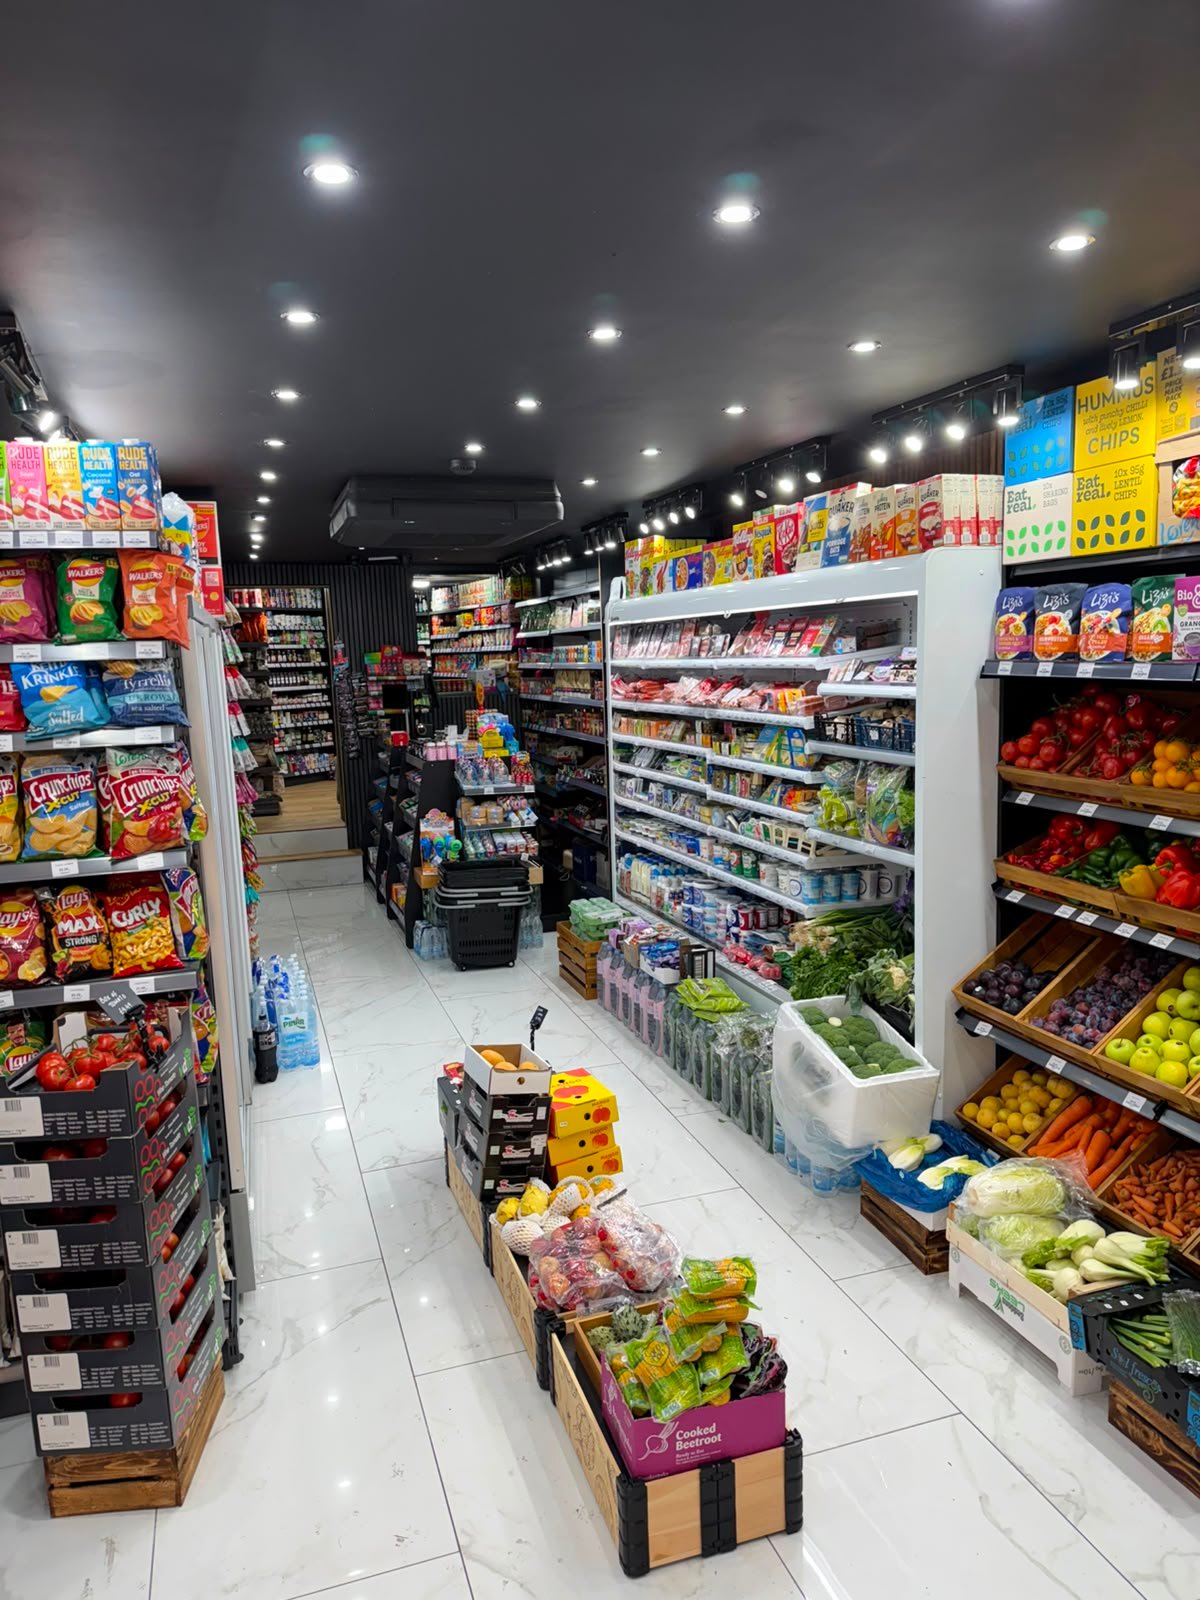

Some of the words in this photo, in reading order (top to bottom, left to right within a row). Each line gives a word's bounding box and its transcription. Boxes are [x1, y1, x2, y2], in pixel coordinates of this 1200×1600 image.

[1077, 376, 1154, 414] HUMMUS
[1165, 385, 1183, 397] MARK
[1165, 393, 1182, 403] PACK
[1083, 415, 1099, 425] with
[1099, 408, 1124, 423] punchy
[1087, 427, 1140, 455] CHIPS
[82, 447, 111, 460] RUDE
[117, 447, 147, 461] RUDE
[11, 460, 41, 470] HEALTH
[48, 461, 78, 470] HEALTH
[84, 460, 114, 470] HEALTH
[119, 460, 149, 471] HEALTH
[1114, 469, 1129, 479] 10x
[1129, 464, 1145, 477] 95g
[1076, 474, 1100, 492] Eat
[1114, 477, 1142, 490] LENTIL
[920, 489, 940, 502] QUAKER
[1007, 488, 1028, 504] Eat
[1076, 483, 1111, 503] real.
[1114, 489, 1138, 501] CHIPS
[1006, 496, 1036, 514] real.
[0, 568, 26, 577] ALKERS
[67, 567, 105, 578] WALKERS
[128, 571, 164, 581] WALKERS
[1002, 596, 1024, 612] Lizi's
[1043, 592, 1070, 610] Lizi's
[1091, 591, 1120, 609] Lizi's
[1142, 587, 1170, 606] Lizi's
[144, 703, 165, 711] salted
[48, 706, 84, 727] Salted
[29, 773, 92, 804] Crunchips
[120, 775, 180, 807] Crunchips
[45, 791, 81, 814] X-CUT
[69, 800, 91, 812] Salted
[136, 791, 170, 817] X-CUT
[61, 890, 90, 910] Lay's
[111, 897, 161, 928] CURLY
[57, 916, 100, 935] MAX
[65, 935, 98, 948] STRONG
[676, 1422, 716, 1440] Cooked
[676, 1433, 722, 1451] Beetroot
